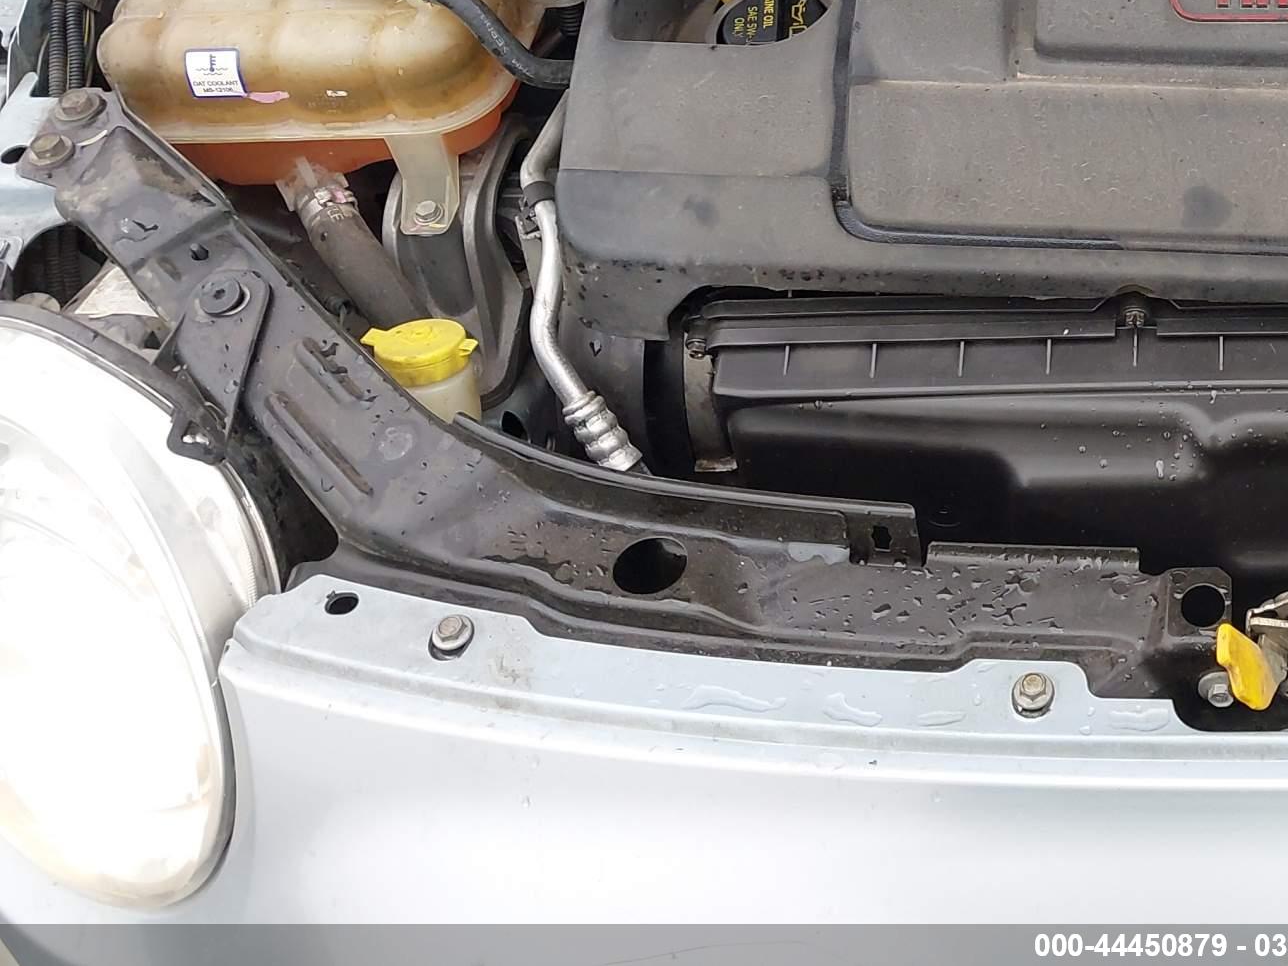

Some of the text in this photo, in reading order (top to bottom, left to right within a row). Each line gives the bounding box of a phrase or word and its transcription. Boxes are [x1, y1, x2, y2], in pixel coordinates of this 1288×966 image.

[732, 17, 745, 38] ONLY
[745, 6, 758, 43] SAE 5W-
[763, 15, 774, 29] OIL
